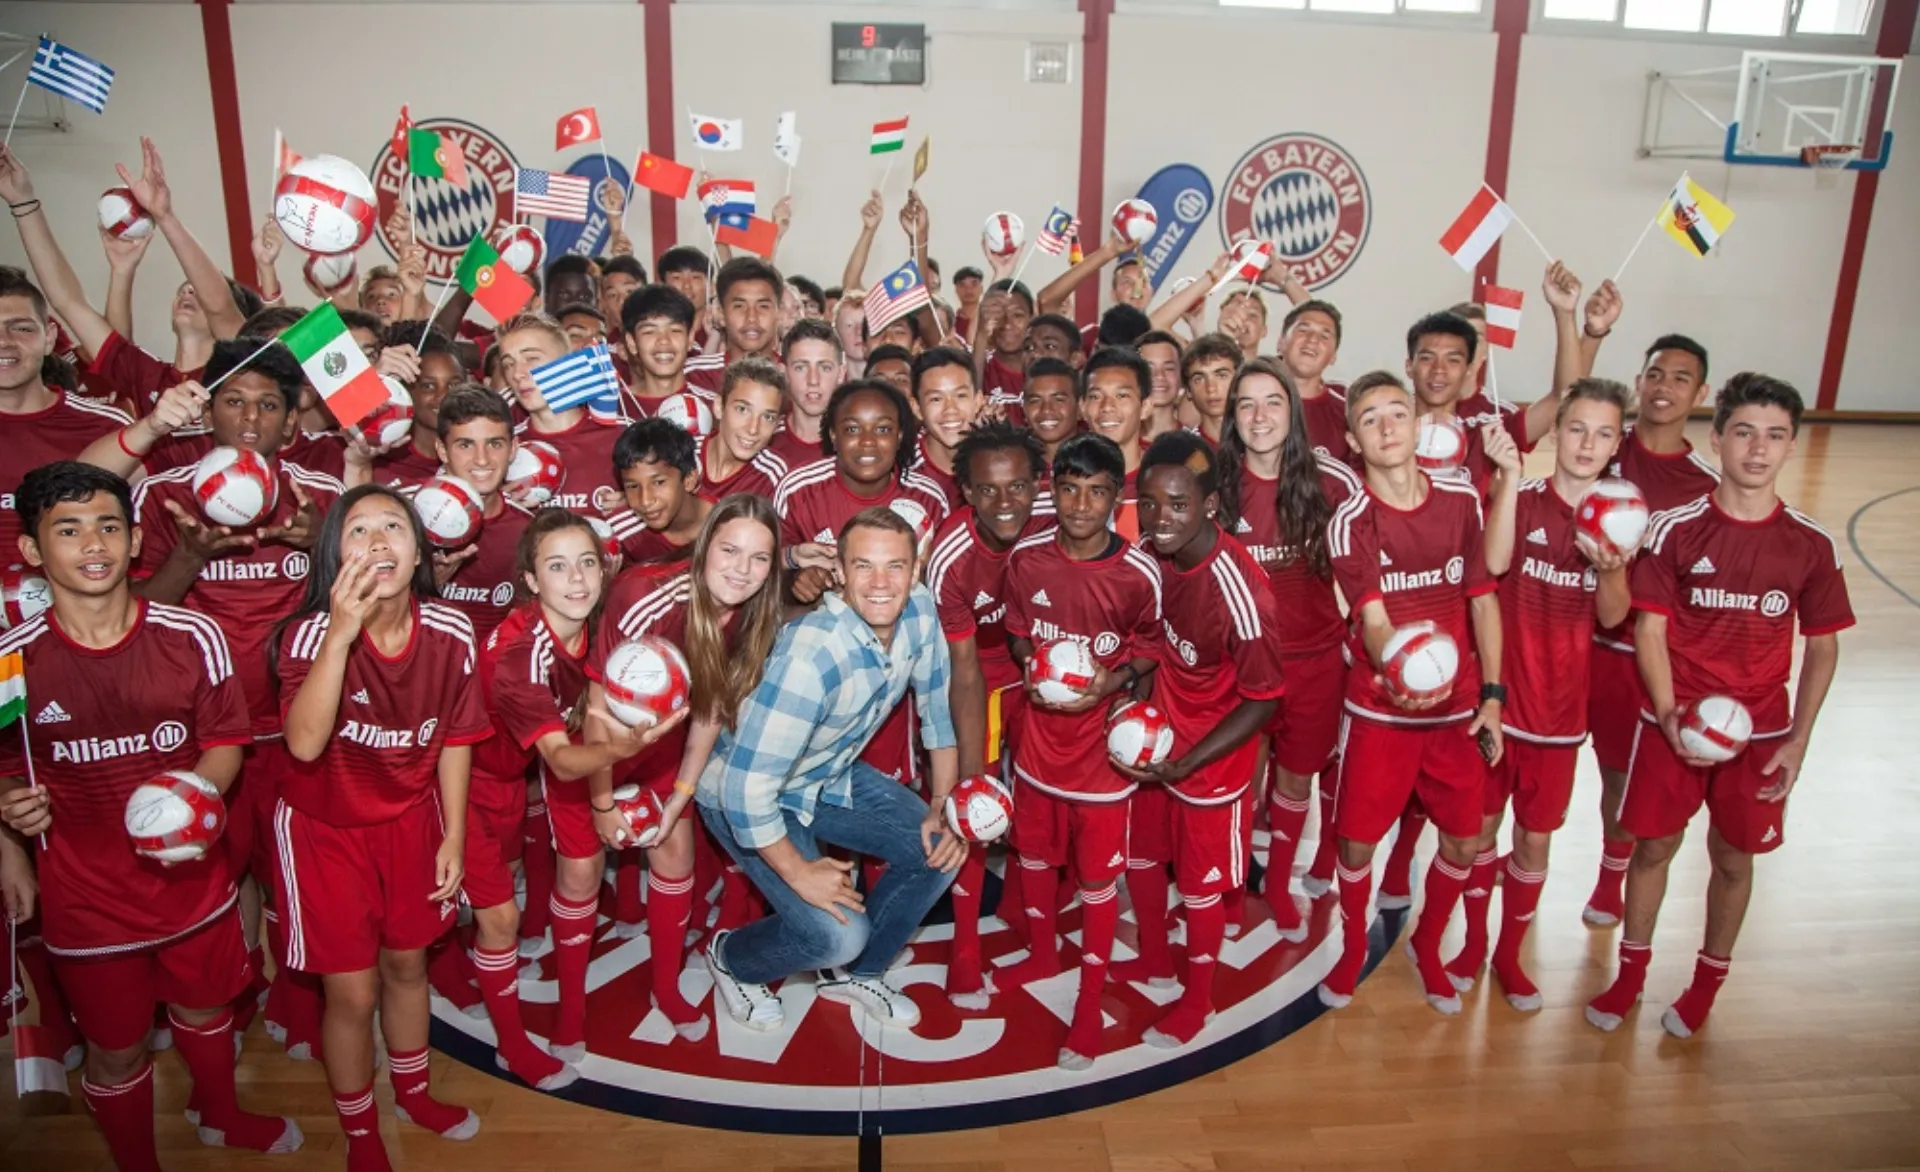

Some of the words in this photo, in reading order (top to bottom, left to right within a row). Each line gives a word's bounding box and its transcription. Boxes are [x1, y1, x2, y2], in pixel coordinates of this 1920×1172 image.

[862, 25, 876, 46] 9
[1232, 166, 1263, 205] FC
[1261, 143, 1361, 207] BAYERN
[1142, 220, 1186, 277] lianz
[1522, 556, 1582, 587] Allinz
[442, 582, 490, 602] lianz
[1689, 587, 1758, 610] Allianz
[51, 733, 150, 764] Allianz
[339, 719, 414, 749] Allinz
